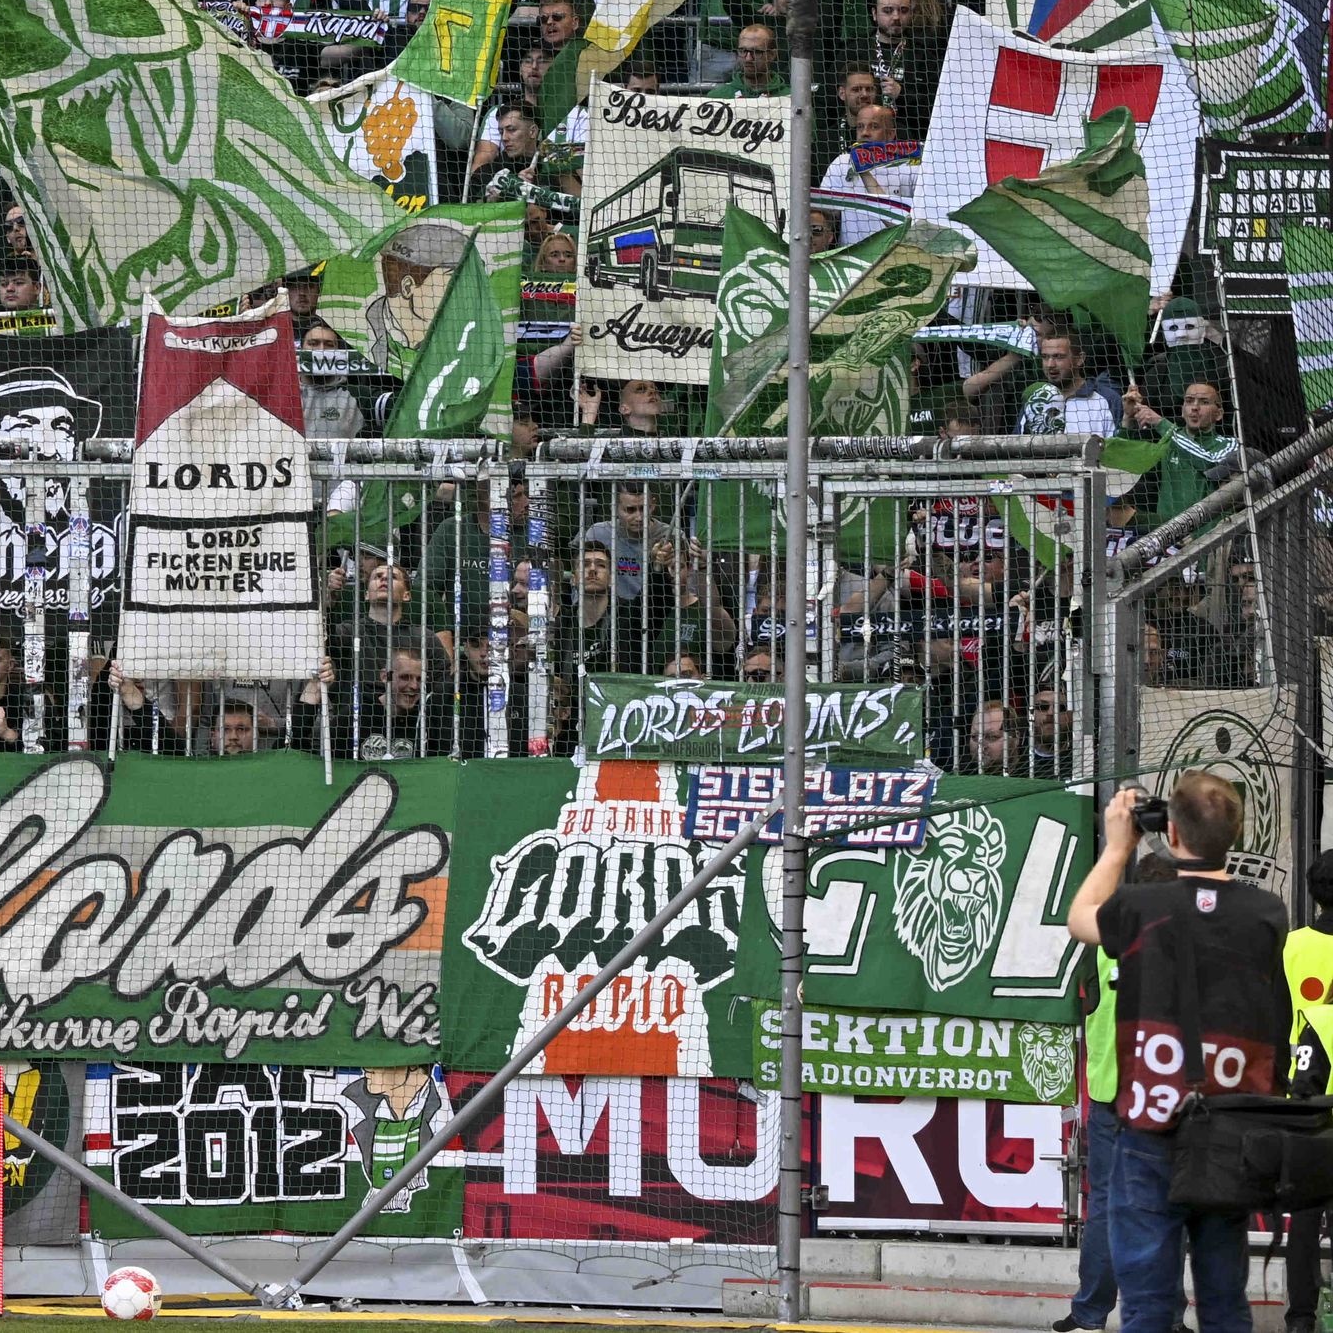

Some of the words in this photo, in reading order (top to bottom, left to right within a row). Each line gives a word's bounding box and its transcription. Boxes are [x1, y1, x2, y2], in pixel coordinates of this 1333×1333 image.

[305, 11, 379, 40] Rapid
[603, 90, 684, 133] Best
[689, 101, 785, 153] Days
[145, 456, 296, 491] LORDS
[185, 525, 262, 550] LORDS
[146, 548, 233, 574] FICKEN
[238, 550, 297, 573] EURE
[163, 568, 264, 595] MÜTTER
[148, 982, 334, 1060] Rapid
[760, 1010, 1015, 1057] SEKTION
[760, 1059, 1013, 1093] SADIONVERBOT
[112, 1103, 348, 1207] 2012
